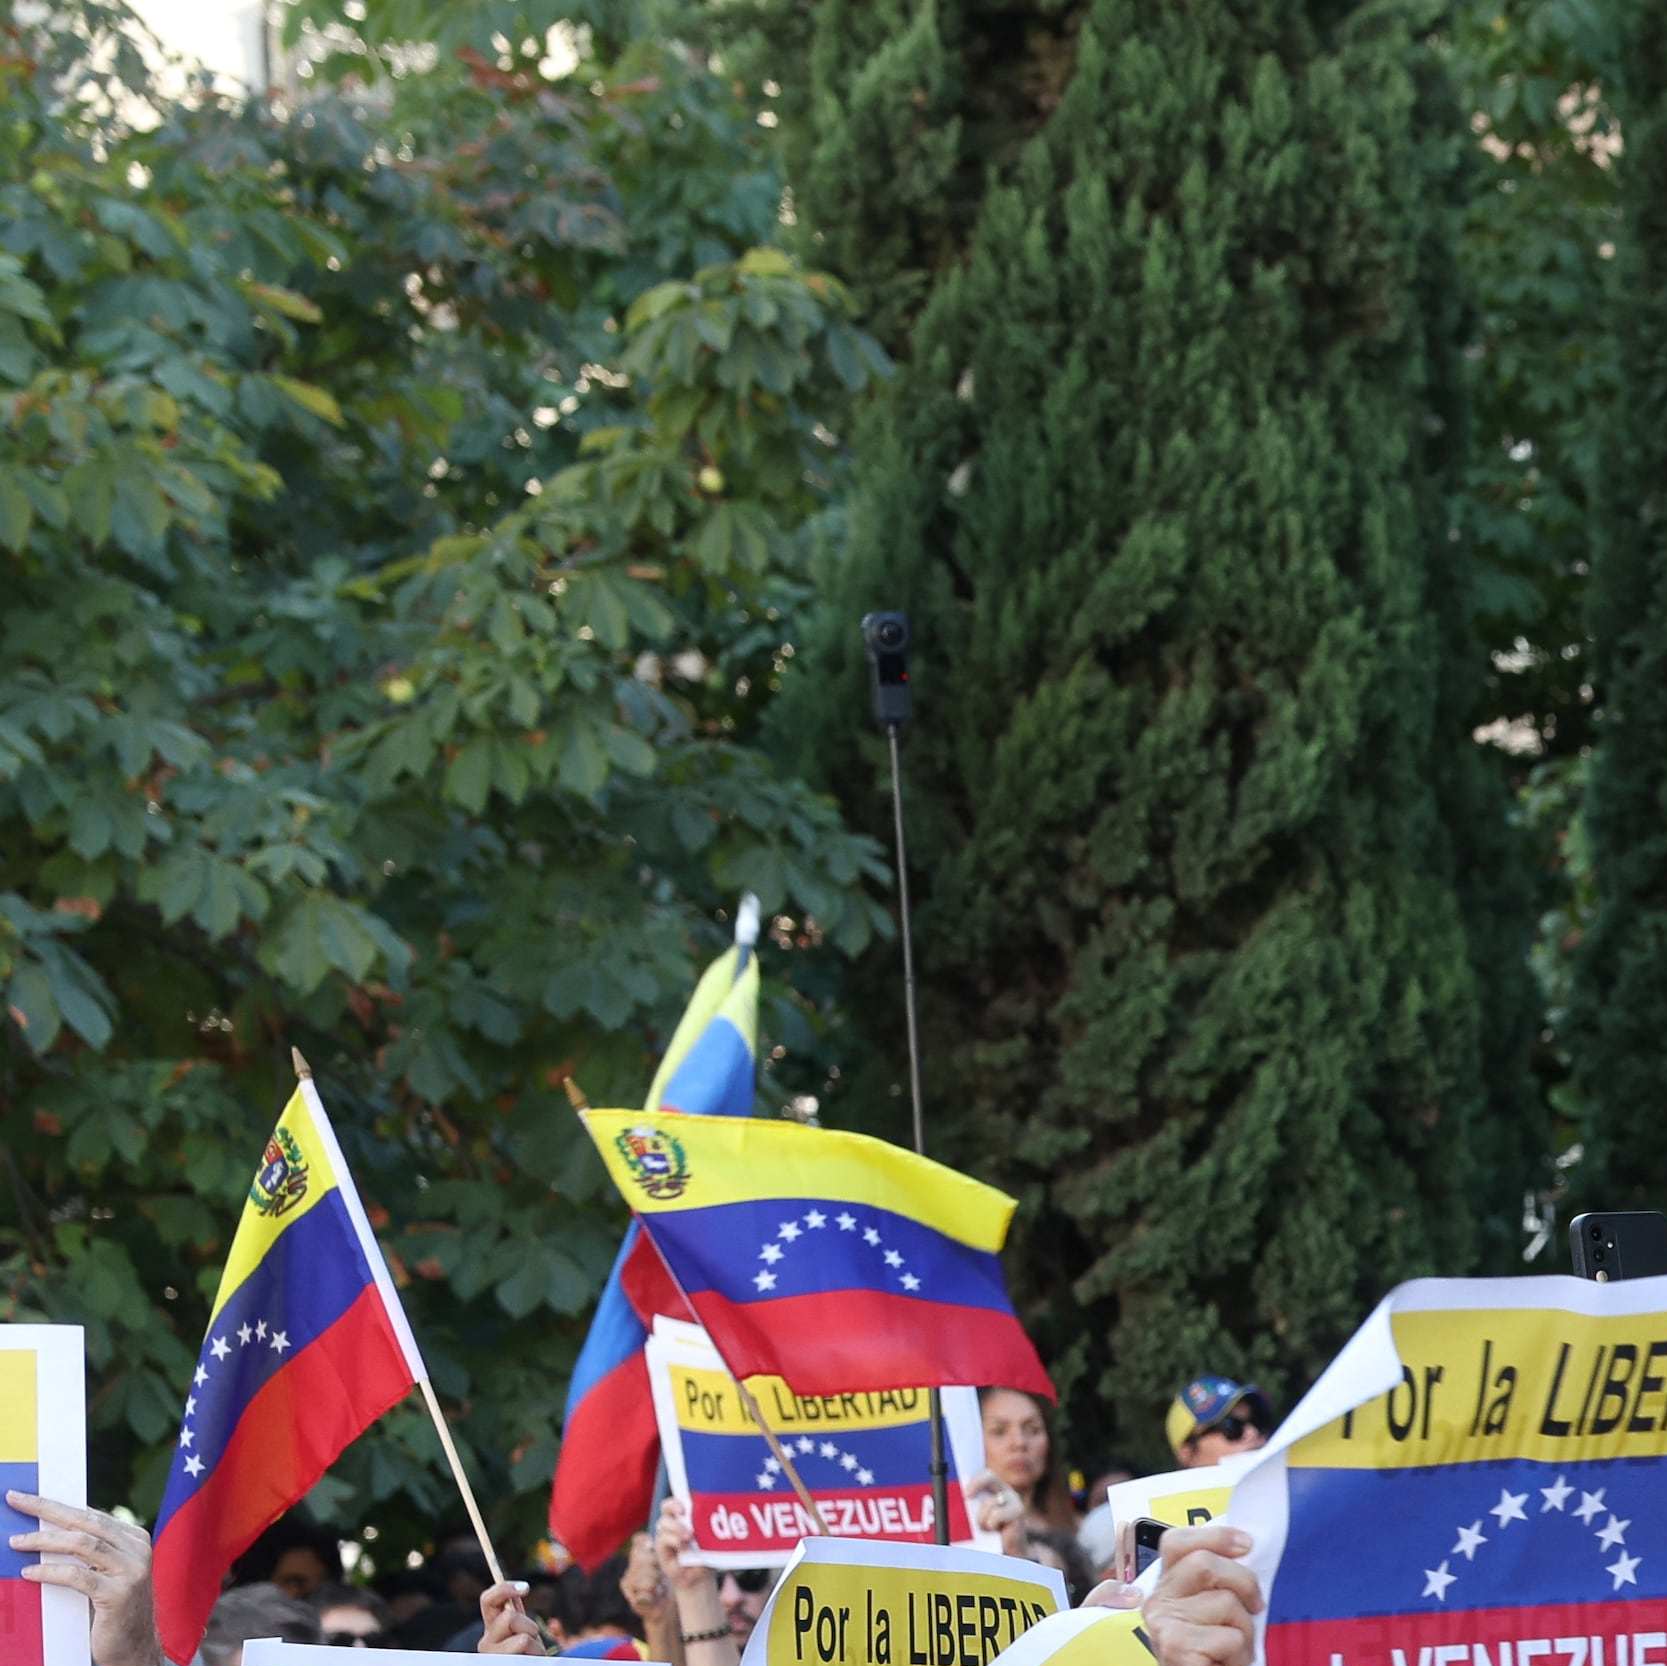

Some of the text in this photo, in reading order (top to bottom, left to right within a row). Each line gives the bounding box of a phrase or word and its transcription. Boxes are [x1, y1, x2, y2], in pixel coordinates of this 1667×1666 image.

[686, 1379, 723, 1422] Por
[1469, 1339, 1517, 1437] la
[710, 1493, 935, 1541] de VENEZUELA
[795, 1586, 850, 1663] Por
[867, 1589, 891, 1664] la
